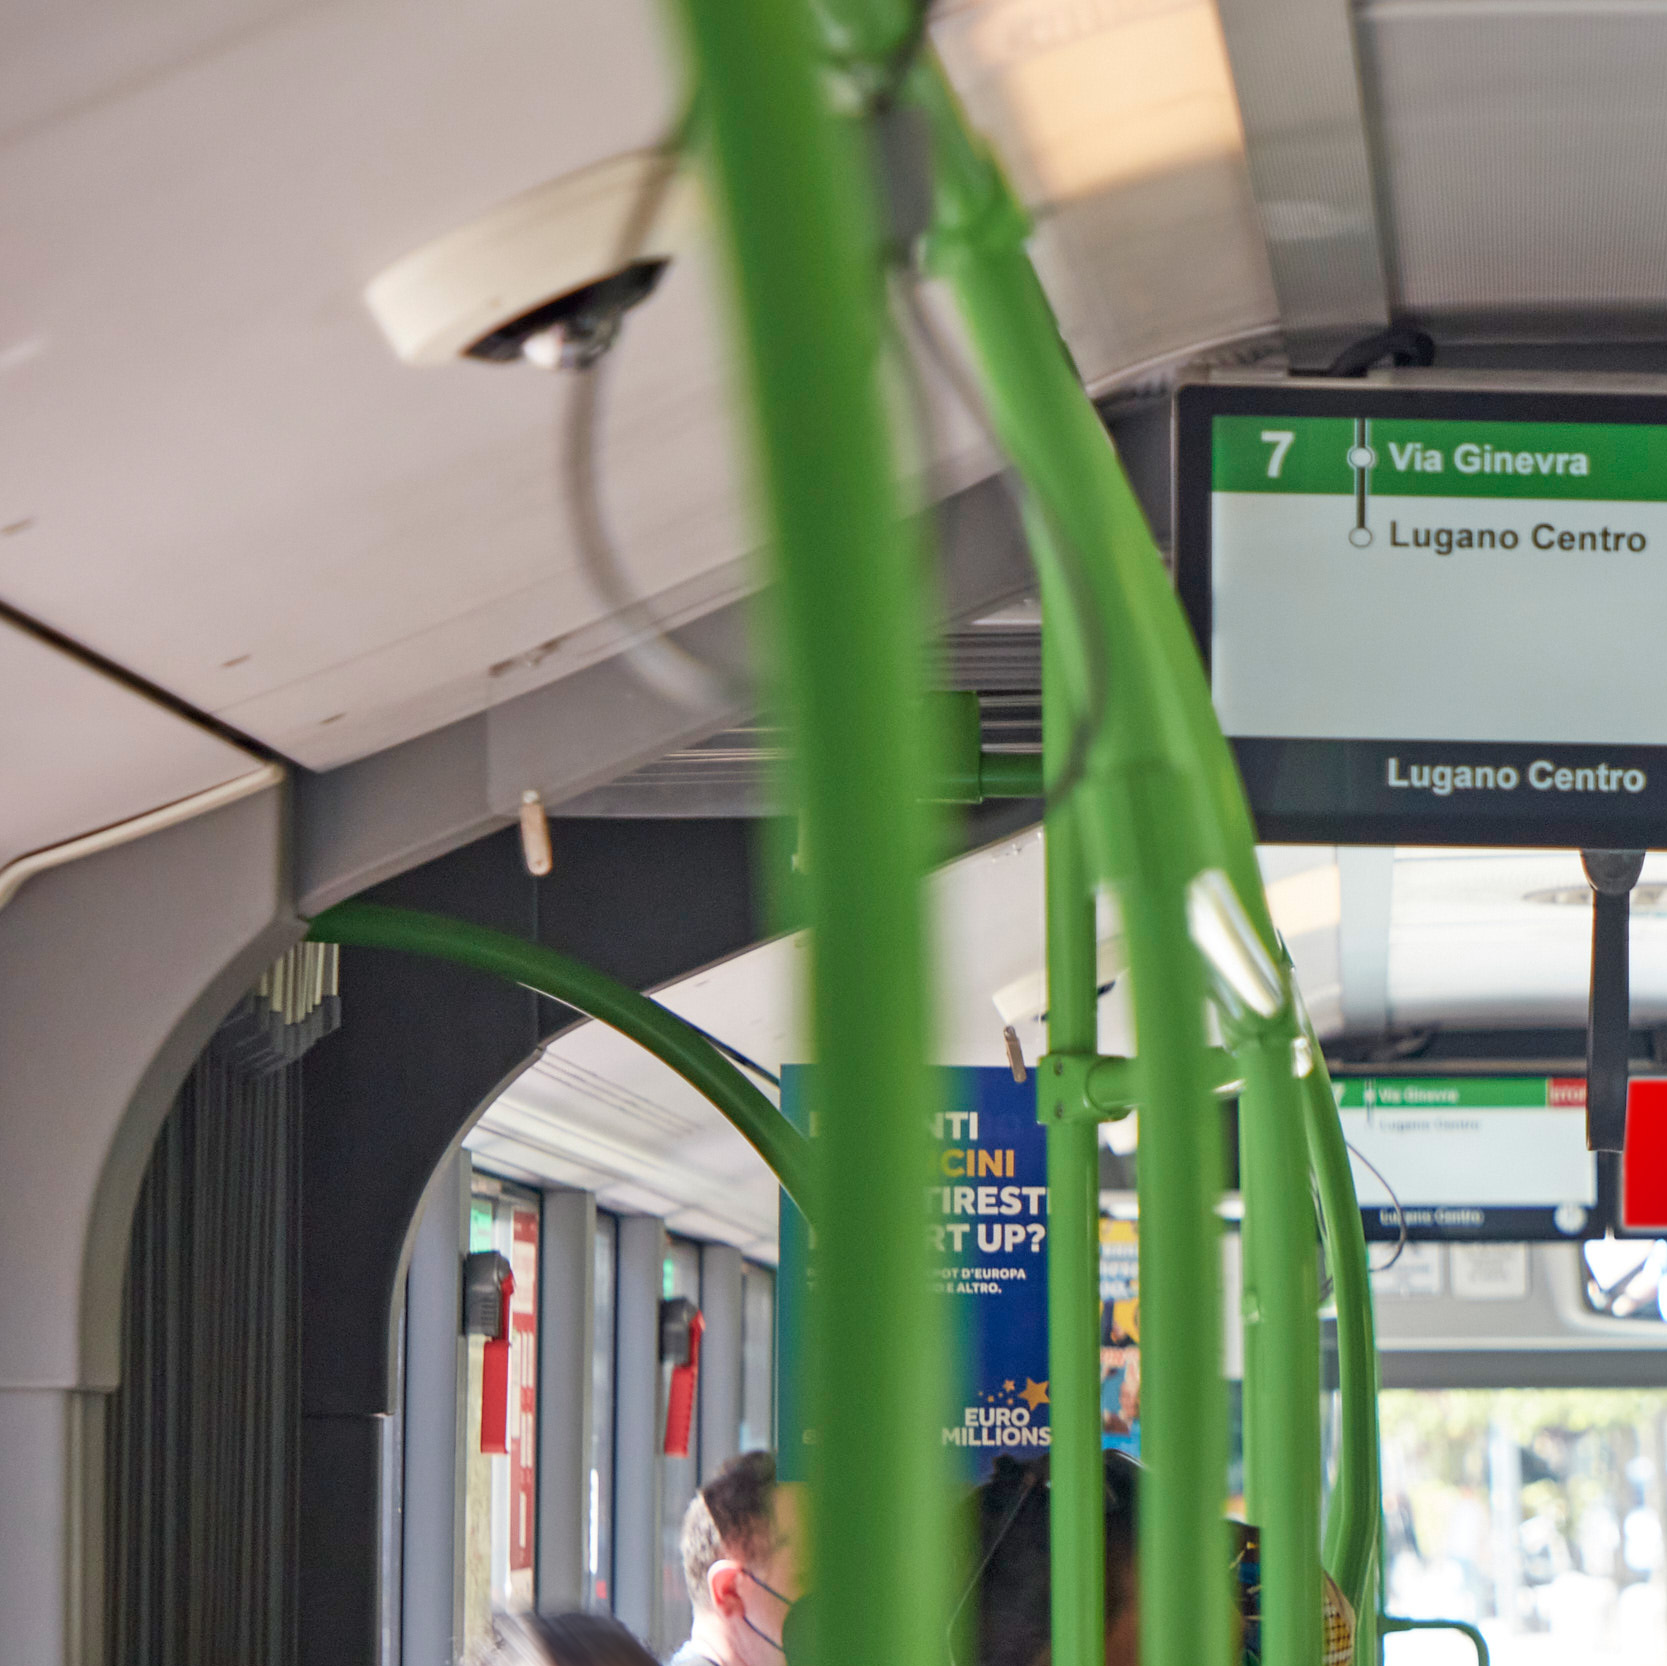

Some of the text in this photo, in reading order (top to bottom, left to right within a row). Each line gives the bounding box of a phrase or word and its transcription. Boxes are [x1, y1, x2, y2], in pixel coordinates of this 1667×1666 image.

[1260, 430, 1295, 478] 7
[1388, 442, 1590, 476] Via Ginevra
[1390, 520, 1647, 556] Lugano Centro
[1387, 757, 1647, 796] Lugano Centro
[977, 1223, 1047, 1253] UP?
[956, 1281, 1003, 1295] ALTRO.
[960, 1267, 1027, 1281] D'EUROPA
[965, 1407, 1031, 1427] EURO
[941, 1427, 1053, 1448] MILLIONS
